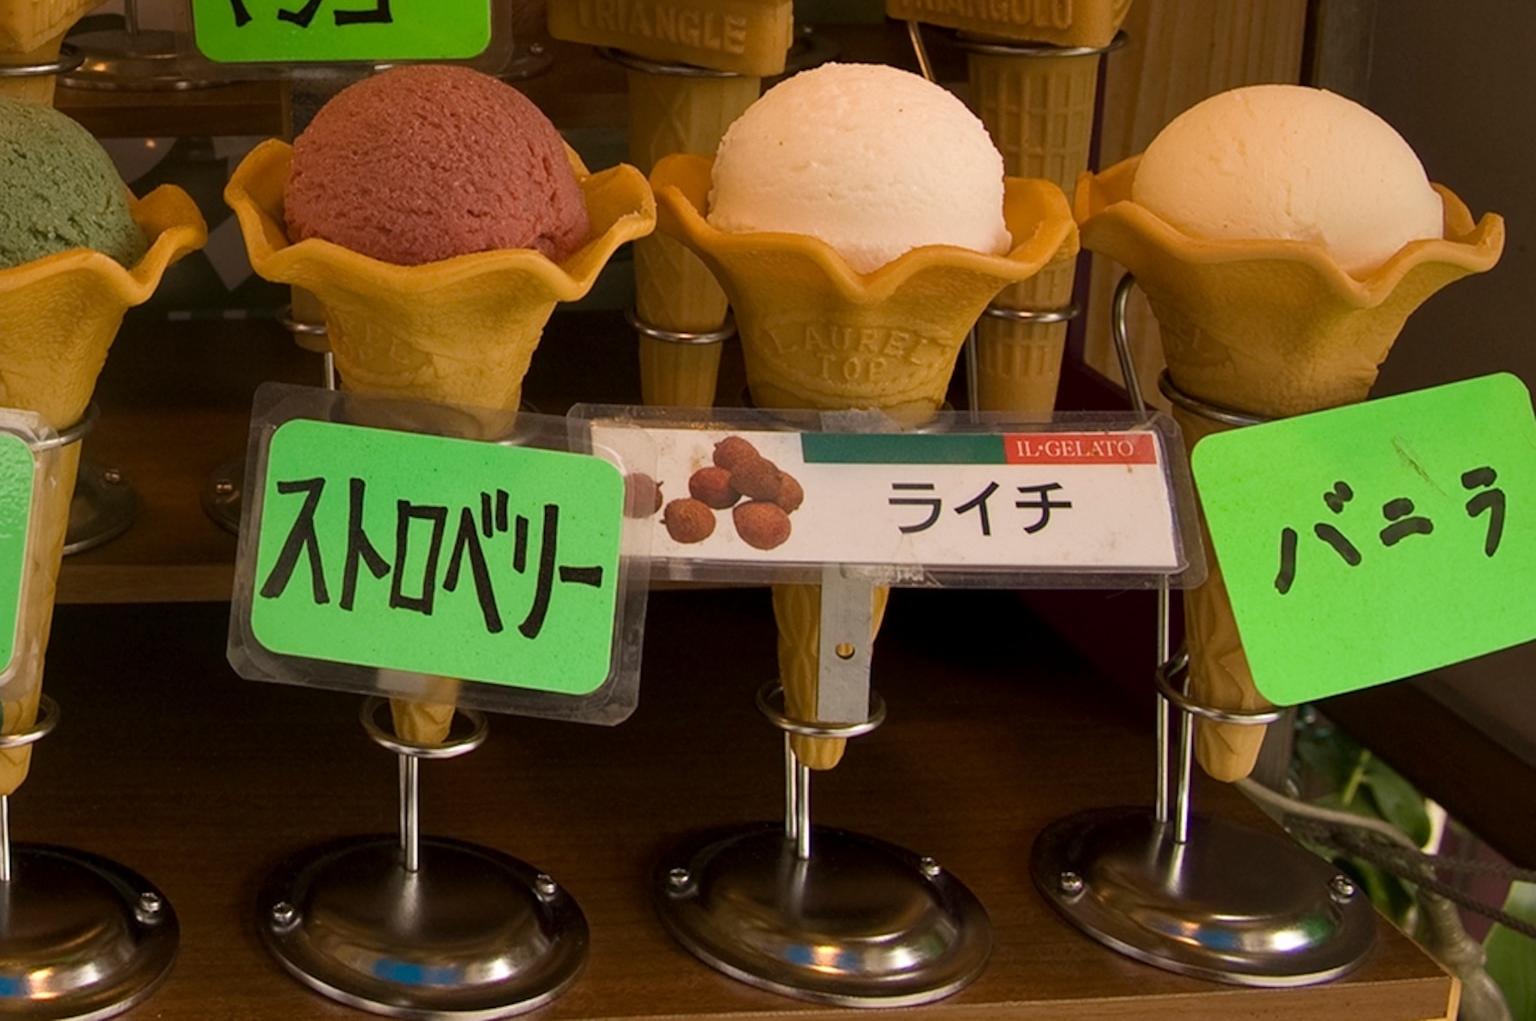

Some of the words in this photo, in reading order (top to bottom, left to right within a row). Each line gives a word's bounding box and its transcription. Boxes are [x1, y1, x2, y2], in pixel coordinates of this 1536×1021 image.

[764, 325, 930, 365] LAUREL
[815, 352, 888, 382] TOP
[888, 481, 1073, 536] ライチ
[1274, 466, 1506, 595] バニラ
[259, 477, 604, 639] ストロベリー
